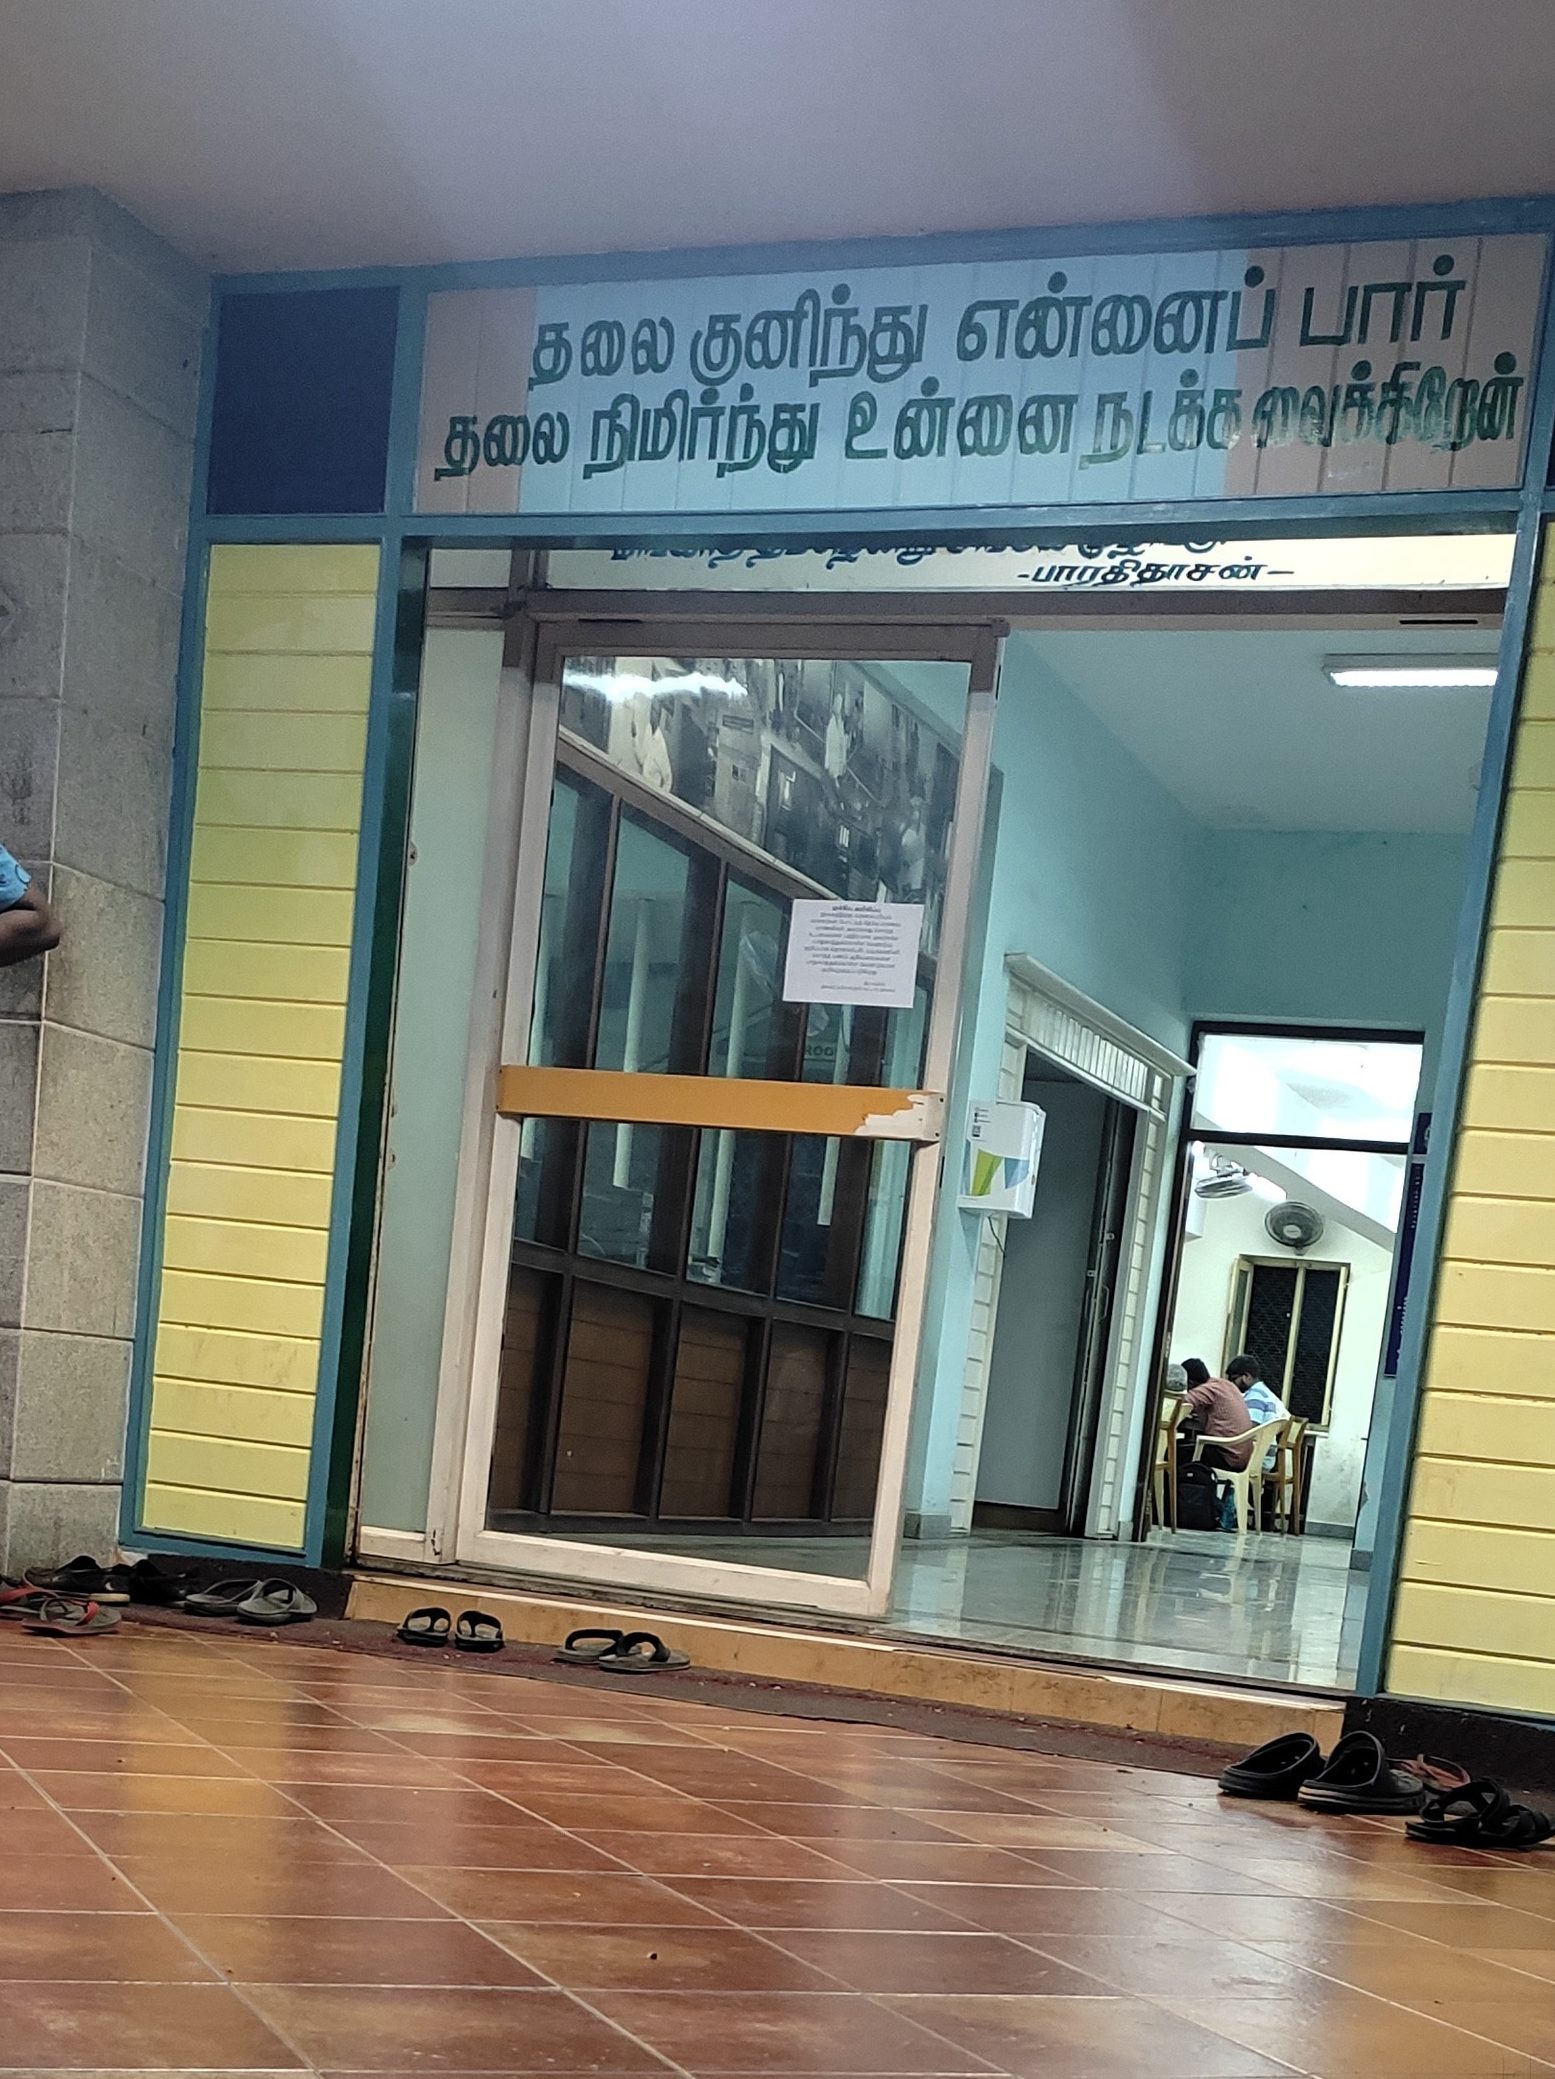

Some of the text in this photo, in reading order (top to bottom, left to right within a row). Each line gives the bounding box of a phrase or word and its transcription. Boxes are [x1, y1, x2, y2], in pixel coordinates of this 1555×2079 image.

[527, 253, 1467, 391] தலை குனிந்து என்னைப் பார்
[434, 410, 570, 482] தலை
[582, 382, 820, 480] நிமிர்ந்து
[844, 374, 1079, 460] உன்னை
